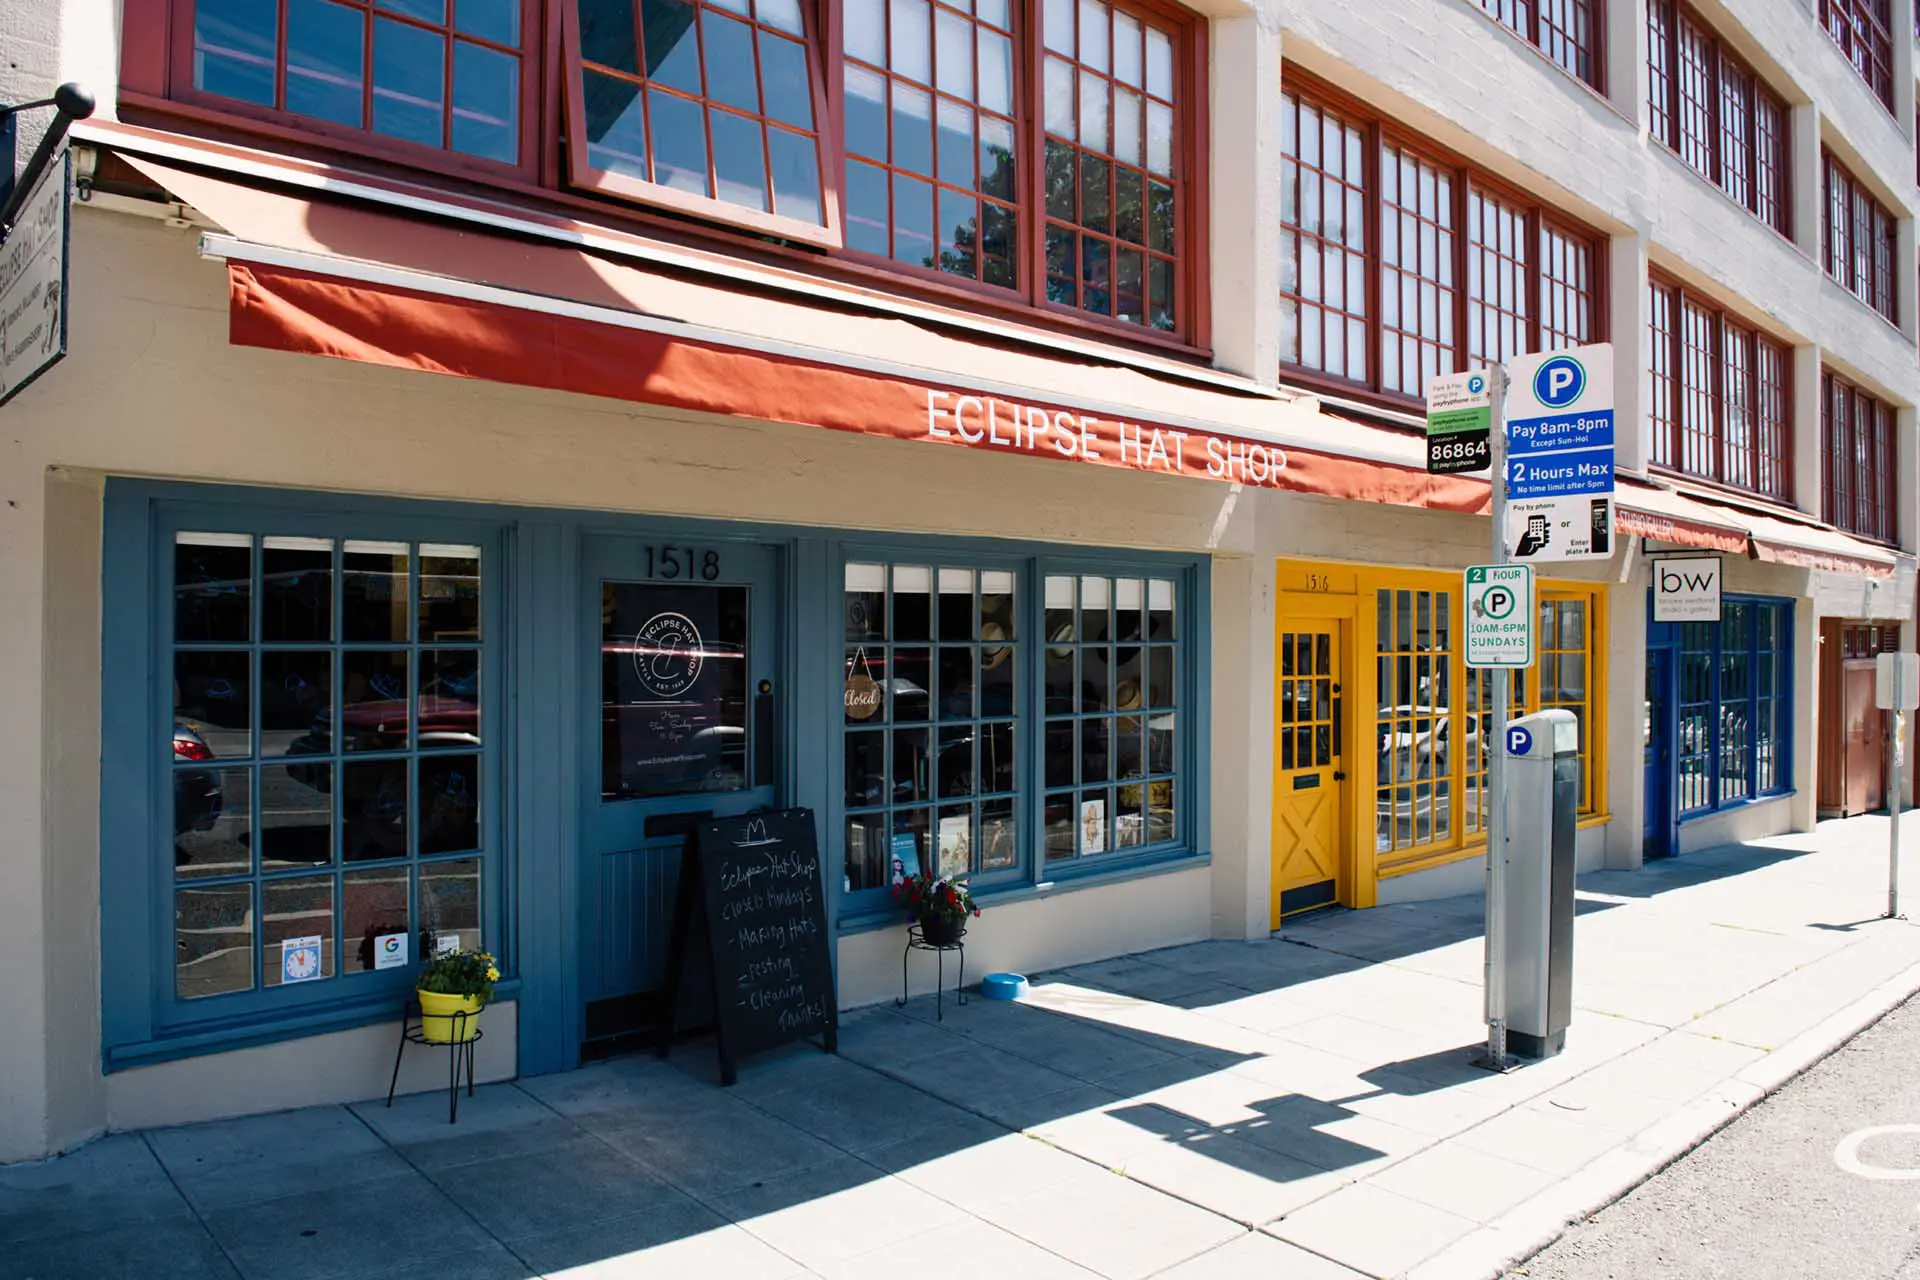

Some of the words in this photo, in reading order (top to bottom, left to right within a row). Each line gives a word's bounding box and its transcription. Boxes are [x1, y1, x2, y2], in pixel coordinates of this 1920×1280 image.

[1549, 367, 1574, 398] P
[927, 388, 1100, 460] ECLIPSE
[1119, 421, 1188, 472] HAT
[1206, 437, 1287, 483] SHOP
[1512, 425, 1537, 439] Pay
[1540, 418, 1609, 434] 8am-8pm
[1431, 441, 1486, 460] 86864
[1531, 438, 1556, 448] Except
[1558, 435, 1589, 445] Sun-Hol
[1513, 463, 1526, 482] 2
[1530, 467, 1574, 480] Hours
[1578, 463, 1609, 477] Max
[1529, 484, 1546, 492] time
[1547, 483, 1566, 491] limit
[1566, 481, 1585, 489] after
[1535, 503, 1556, 511] phone
[1560, 520, 1571, 528] or
[645, 545, 720, 581] 1518
[1305, 572, 1329, 592] 1516
[1472, 568, 1482, 580] 2
[1661, 567, 1714, 593] bw
[1492, 593, 1507, 612] P
[645, 619, 681, 639] ECLIPSE
[681, 625, 696, 643] HAT
[1471, 637, 1526, 647] SUNDAYS
[844, 689, 877, 706] Closed
[1511, 731, 1527, 750] P
[721, 861, 768, 891] Eclipse
[764, 852, 791, 881] Hat
[790, 850, 817, 880] Shop
